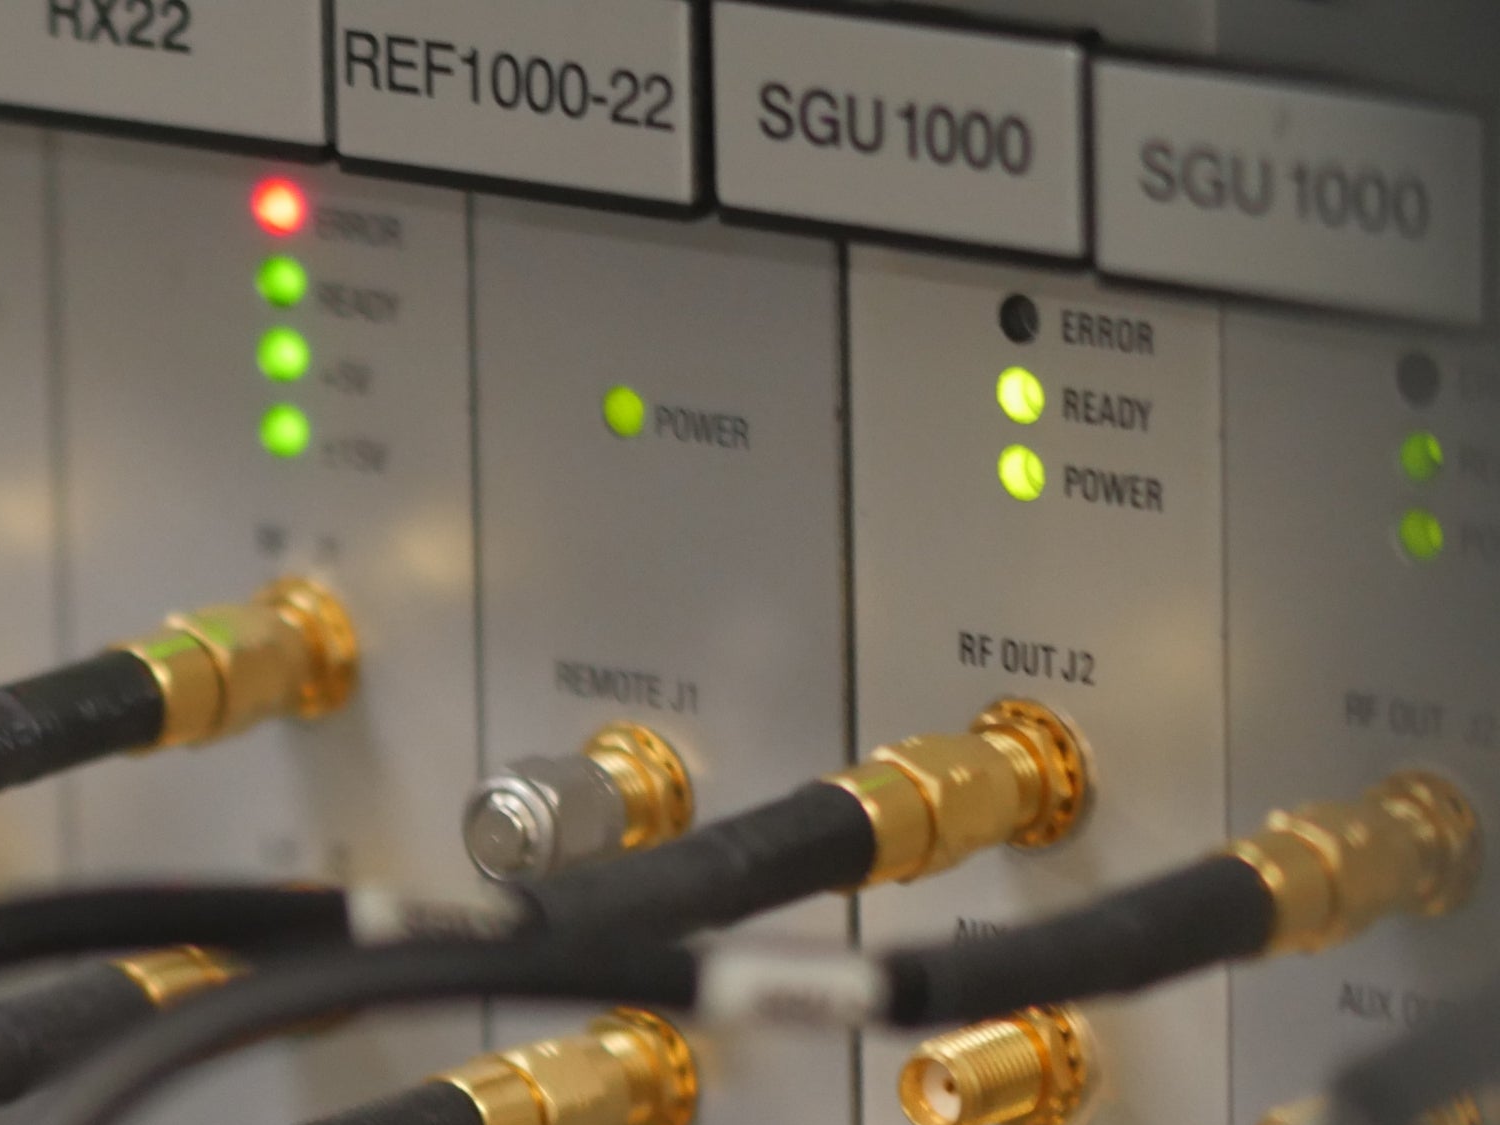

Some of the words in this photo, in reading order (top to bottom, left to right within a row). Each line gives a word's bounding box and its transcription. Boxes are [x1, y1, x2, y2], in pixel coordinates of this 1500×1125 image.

[47, 0, 192, 54] RX22
[343, 30, 676, 132] REF1000-22
[1061, 309, 1154, 355] ERROR
[654, 404, 751, 451] POWER
[1062, 386, 1153, 431] READY
[1064, 463, 1164, 513] POWER
[958, 630, 992, 668] RF
[1001, 637, 1056, 679] OUT
[1061, 648, 1096, 687] J2
[554, 658, 662, 710] REMOTE
[667, 680, 699, 715] J1
